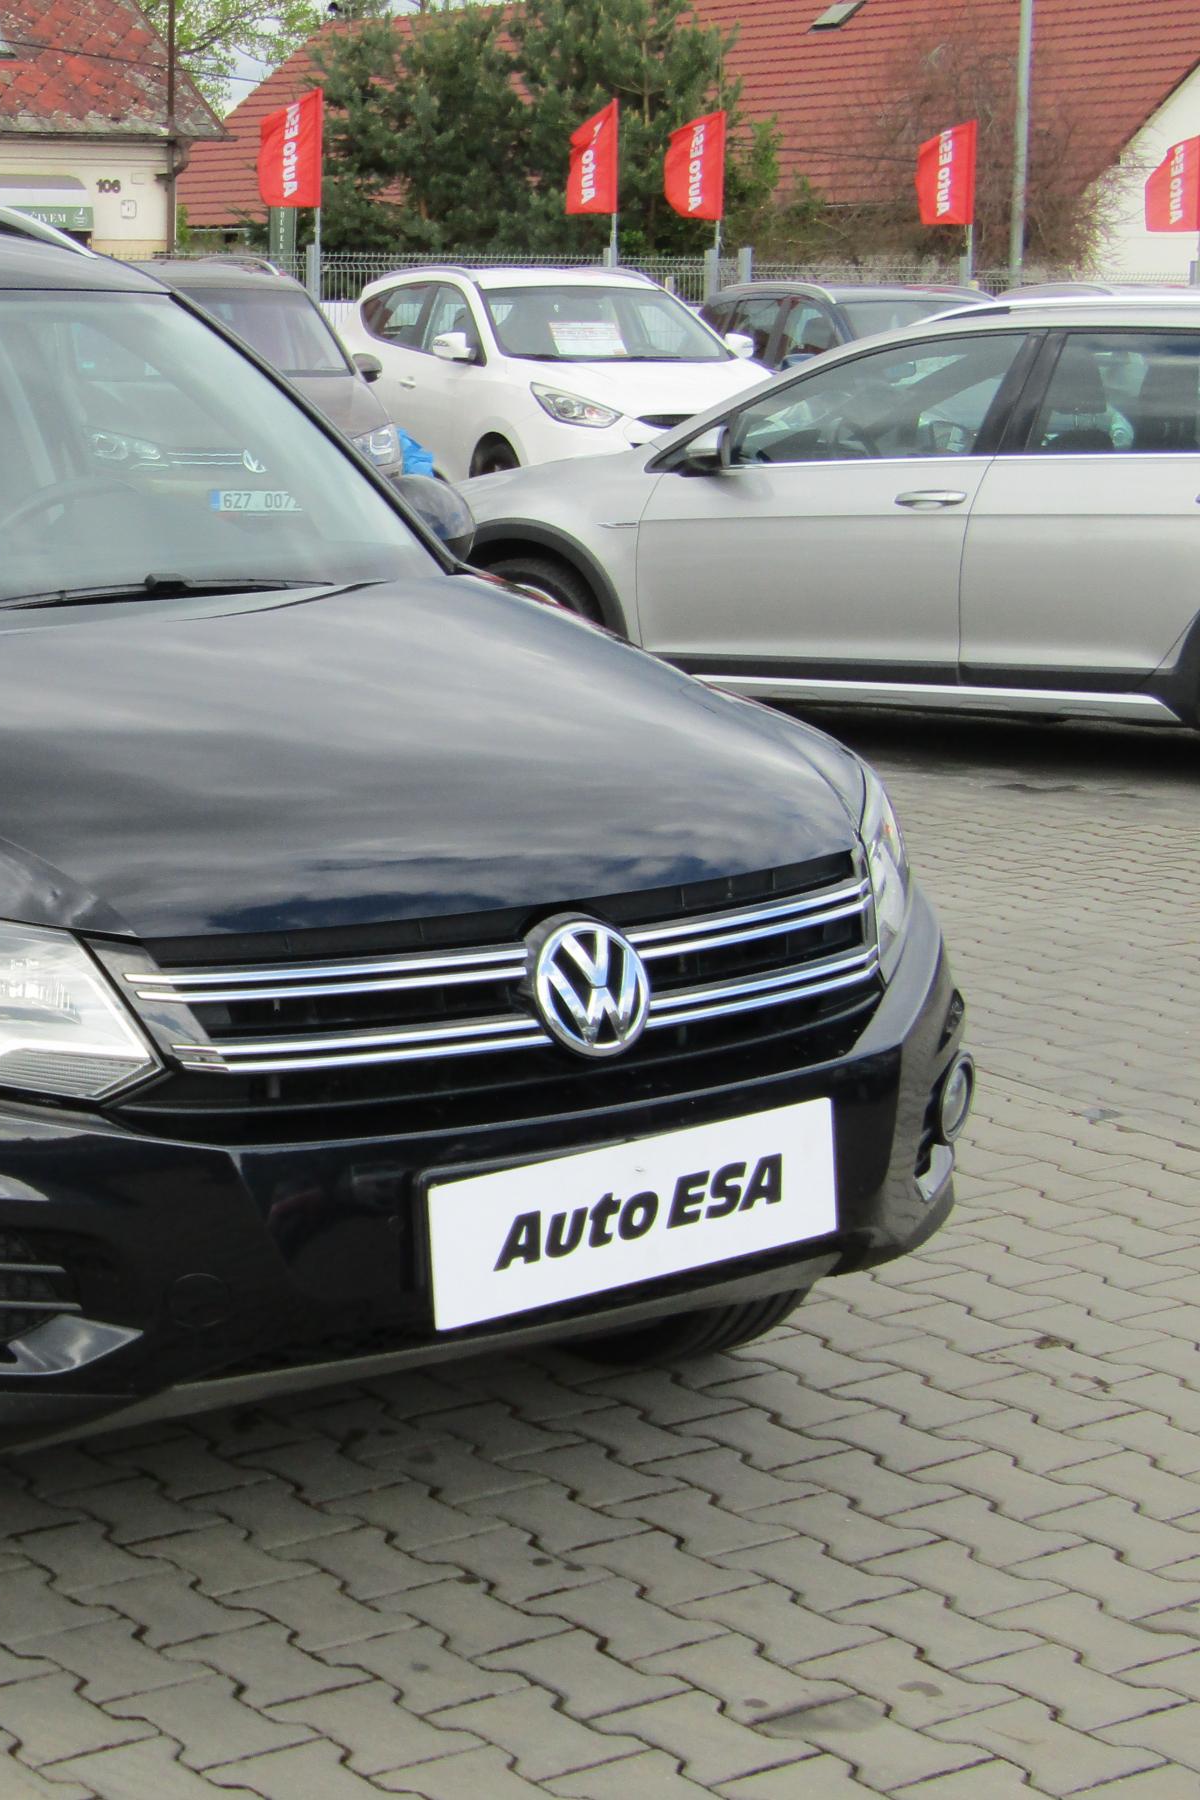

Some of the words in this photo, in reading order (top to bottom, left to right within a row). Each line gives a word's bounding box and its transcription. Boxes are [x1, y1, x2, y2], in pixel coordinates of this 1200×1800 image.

[264, 493, 301, 509] 007
[493, 1191, 660, 1271] Auto
[667, 1153, 783, 1229] ESA
